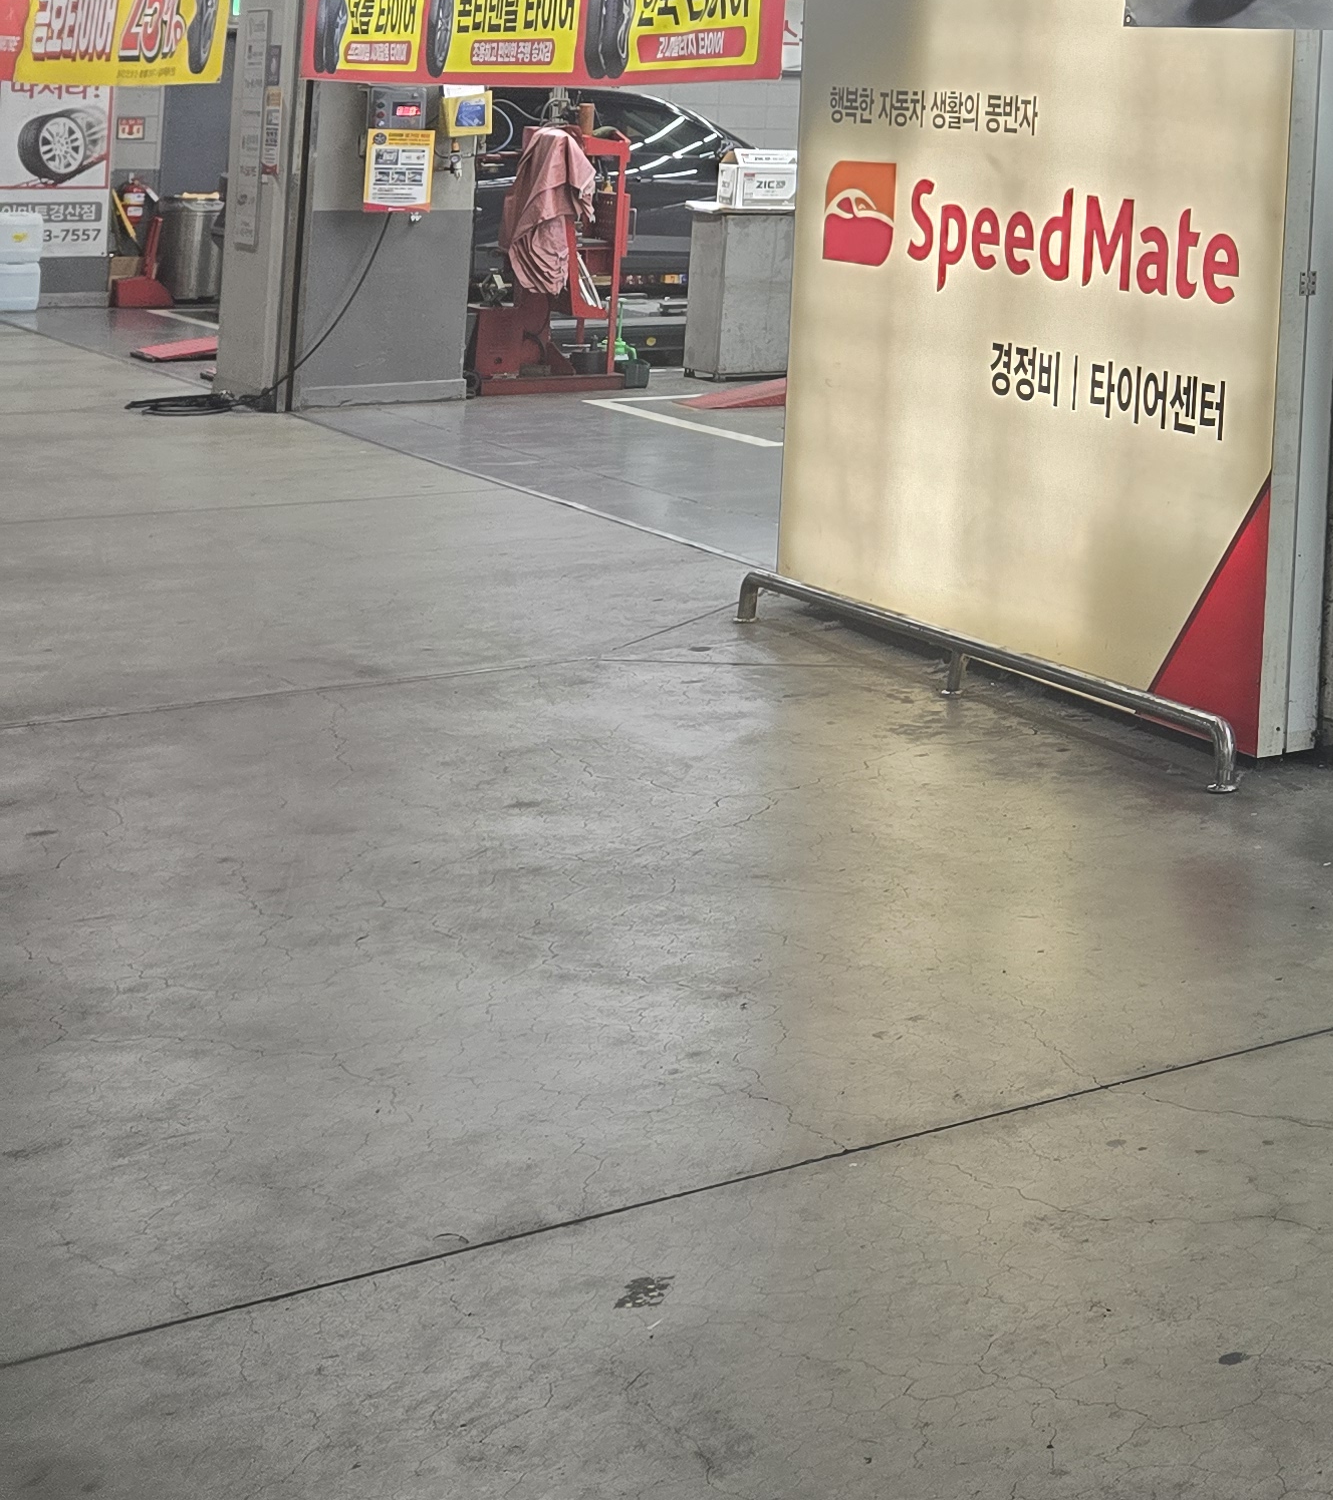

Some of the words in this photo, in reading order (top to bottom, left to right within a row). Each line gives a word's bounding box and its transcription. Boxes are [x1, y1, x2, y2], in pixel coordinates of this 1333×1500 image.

[829, 86, 875, 124] 행복한
[878, 90, 926, 129] 자동차
[930, 91, 980, 131] 생활의
[984, 94, 1039, 136] 동반자
[755, 180, 775, 189] ZIC
[906, 178, 1241, 305] SpeedMate
[989, 340, 1061, 407] 경정비
[1089, 360, 1226, 442] 타이어센터
